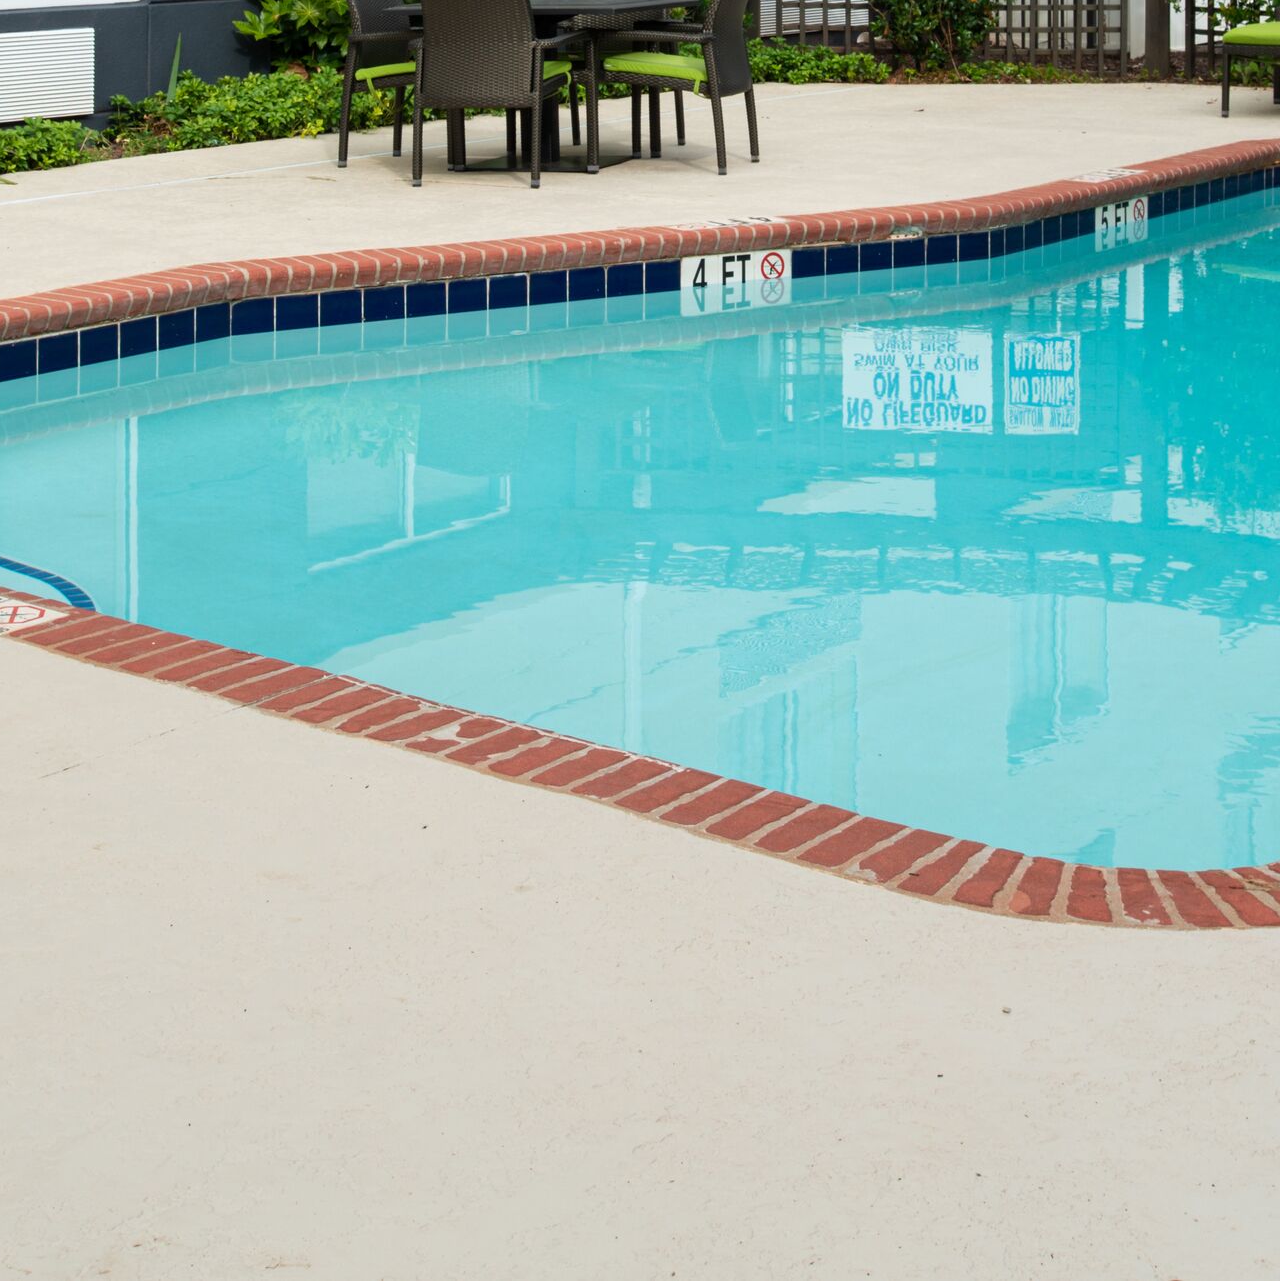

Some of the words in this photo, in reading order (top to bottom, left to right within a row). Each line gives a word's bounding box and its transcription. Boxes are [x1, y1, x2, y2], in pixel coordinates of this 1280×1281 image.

[1101, 206, 1108, 230] 5
[1115, 201, 1129, 227] FT
[693, 258, 707, 288] 4
[722, 254, 751, 285] FT
